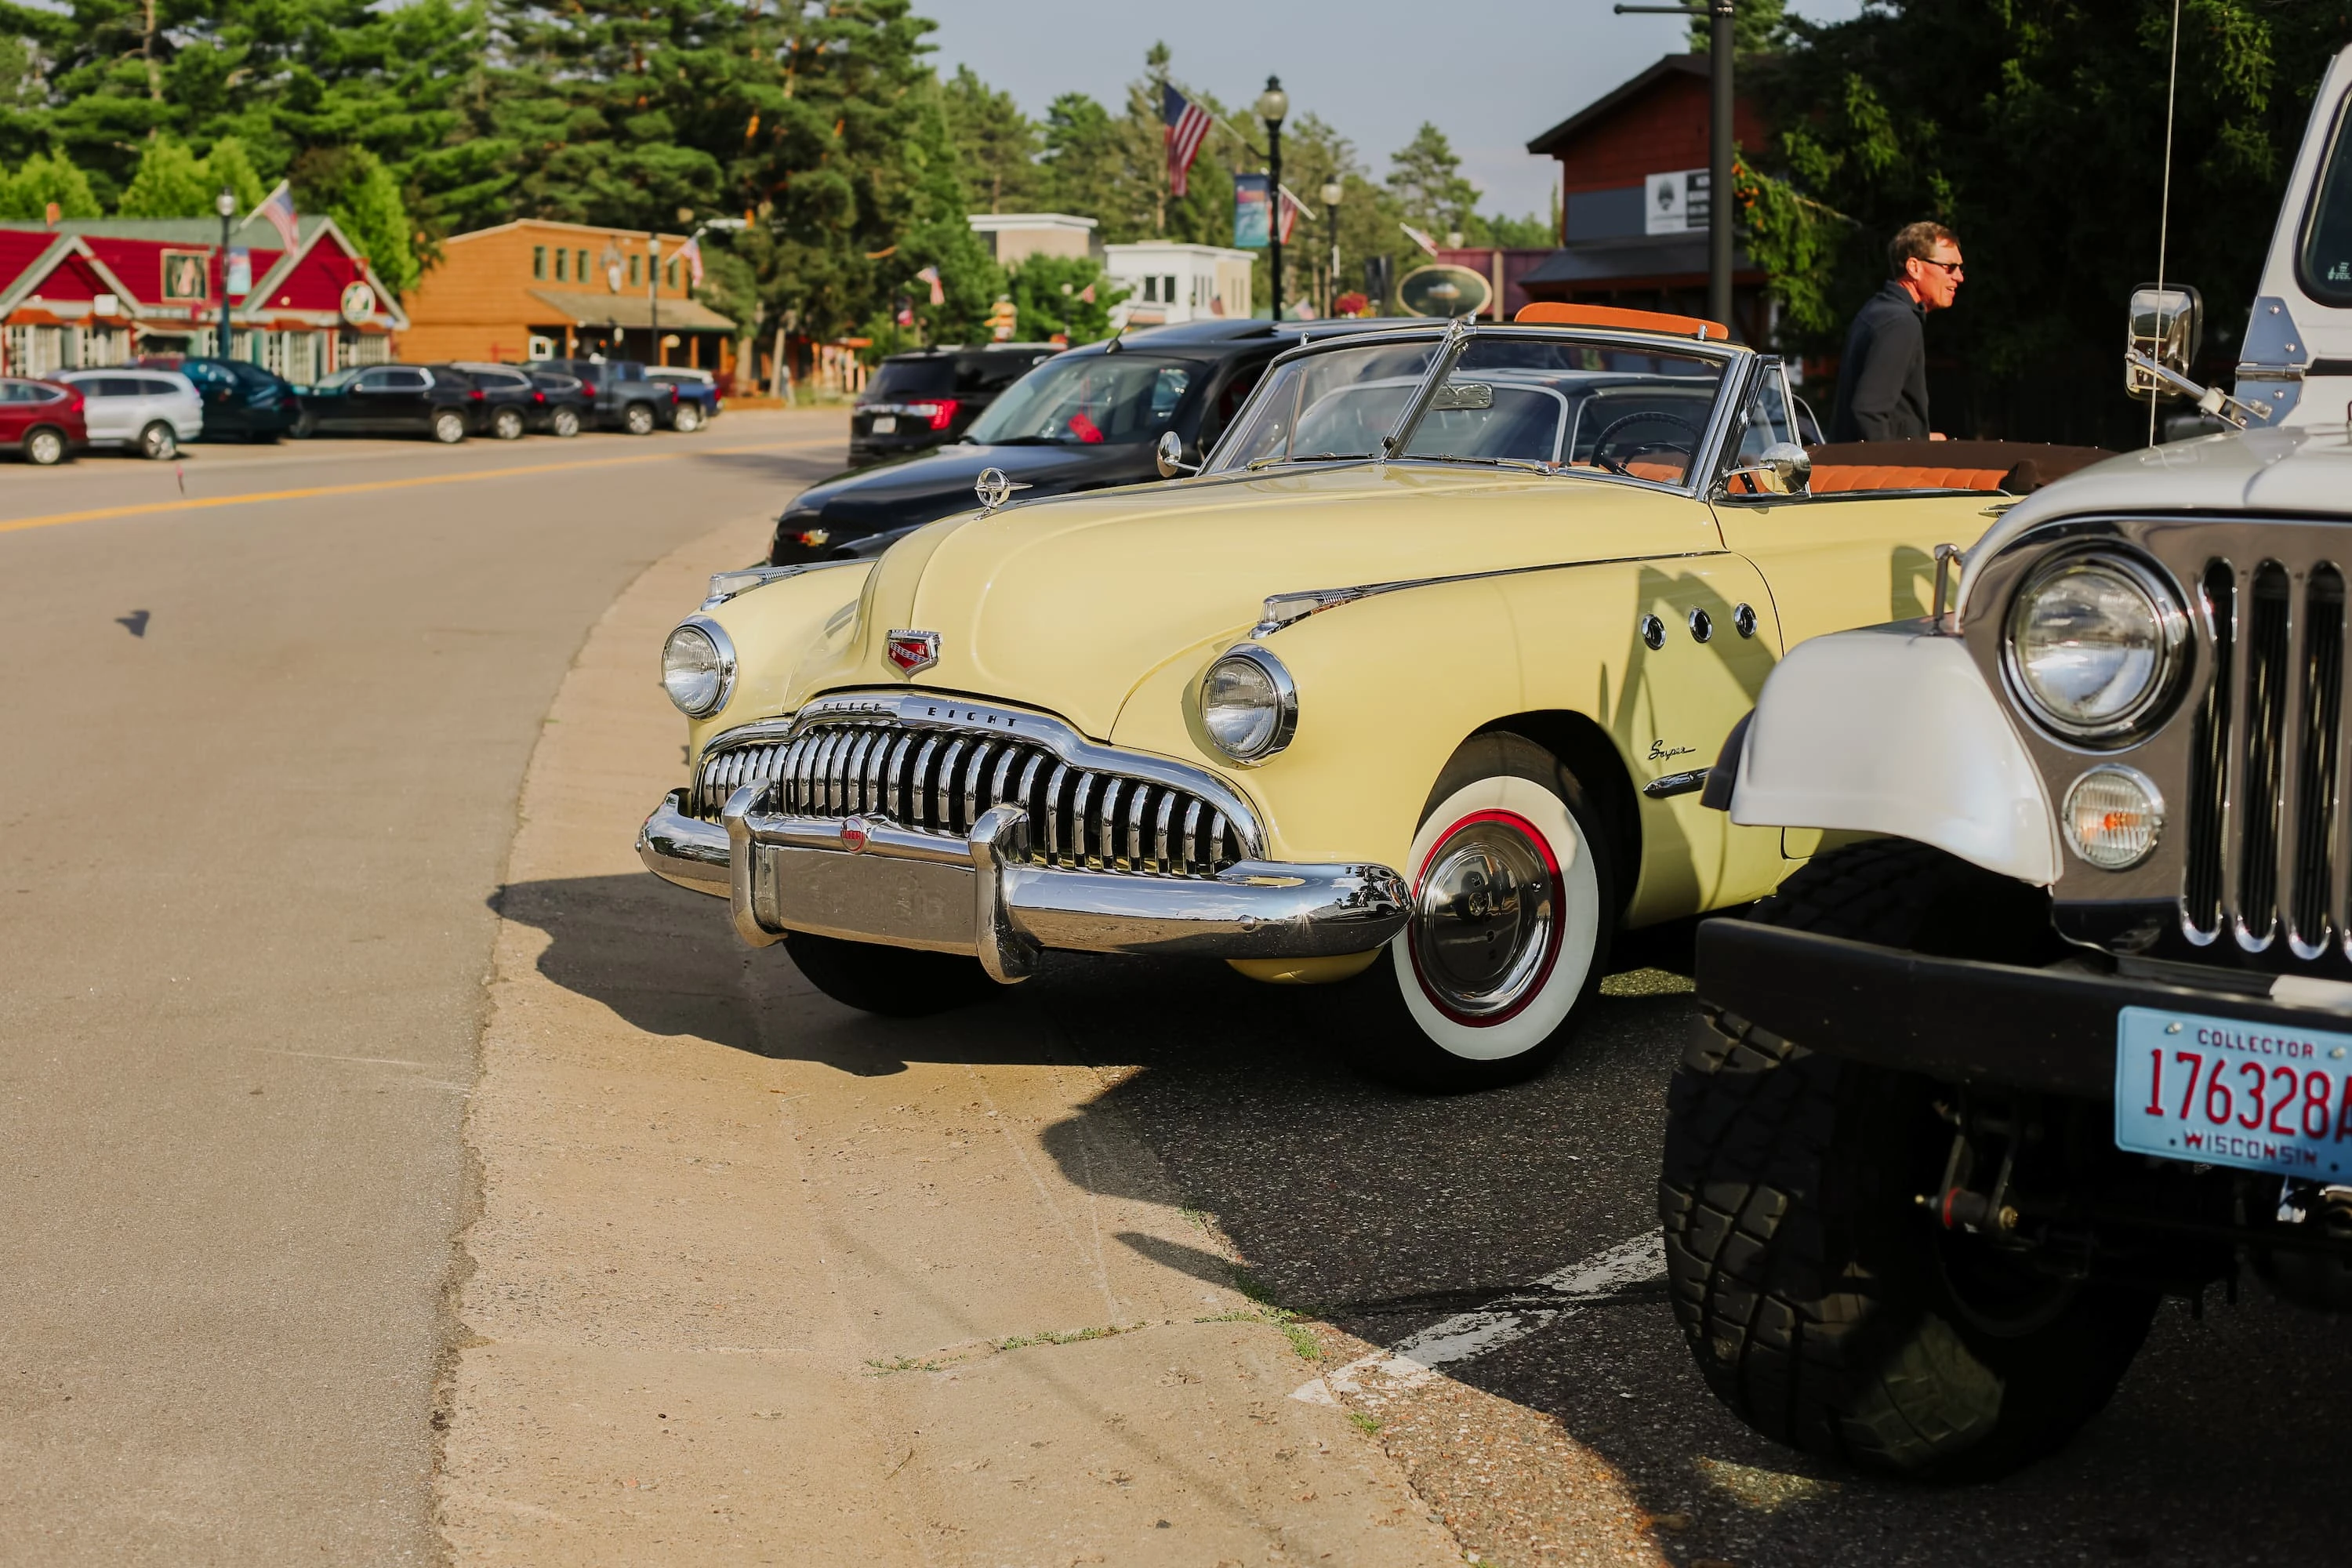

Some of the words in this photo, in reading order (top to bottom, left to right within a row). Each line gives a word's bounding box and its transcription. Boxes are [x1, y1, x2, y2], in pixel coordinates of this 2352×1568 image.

[927, 707, 1016, 727] EIGHT
[2198, 1028, 2314, 1057] COLLECTOR
[2183, 1132, 2318, 1166] WISCONSIN
